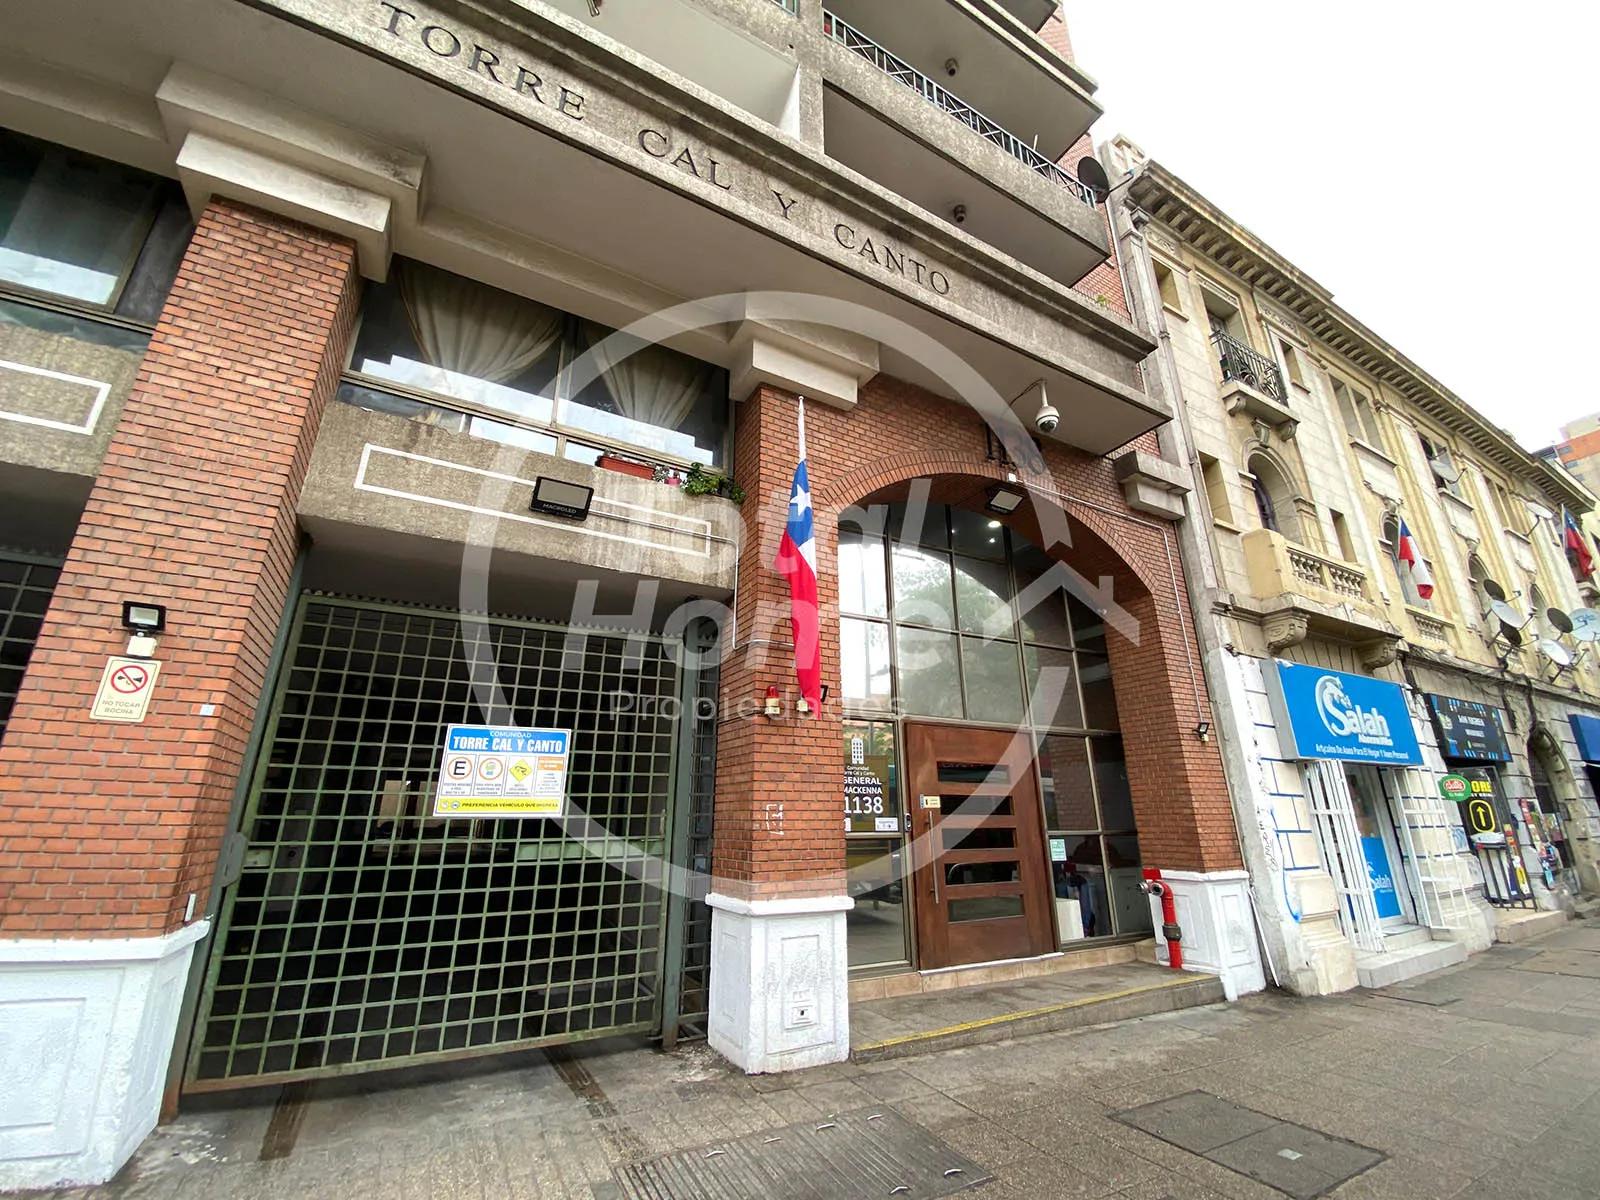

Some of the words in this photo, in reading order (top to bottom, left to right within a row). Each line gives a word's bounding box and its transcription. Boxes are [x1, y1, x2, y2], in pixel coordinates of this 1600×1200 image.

[380, 2, 586, 121] TORRE
[637, 129, 732, 190] CAL
[770, 189, 797, 219] Y
[833, 223, 950, 295] CANTO
[1323, 682, 1390, 737] Salah
[490, 730, 532, 739] COMUNIDAD
[453, 736, 489, 751] TORRE
[492, 737, 513, 752] CAL
[517, 738, 525, 752] Y
[527, 739, 563, 753] CANTO
[453, 761, 466, 776] E
[844, 796, 883, 814] 1138
